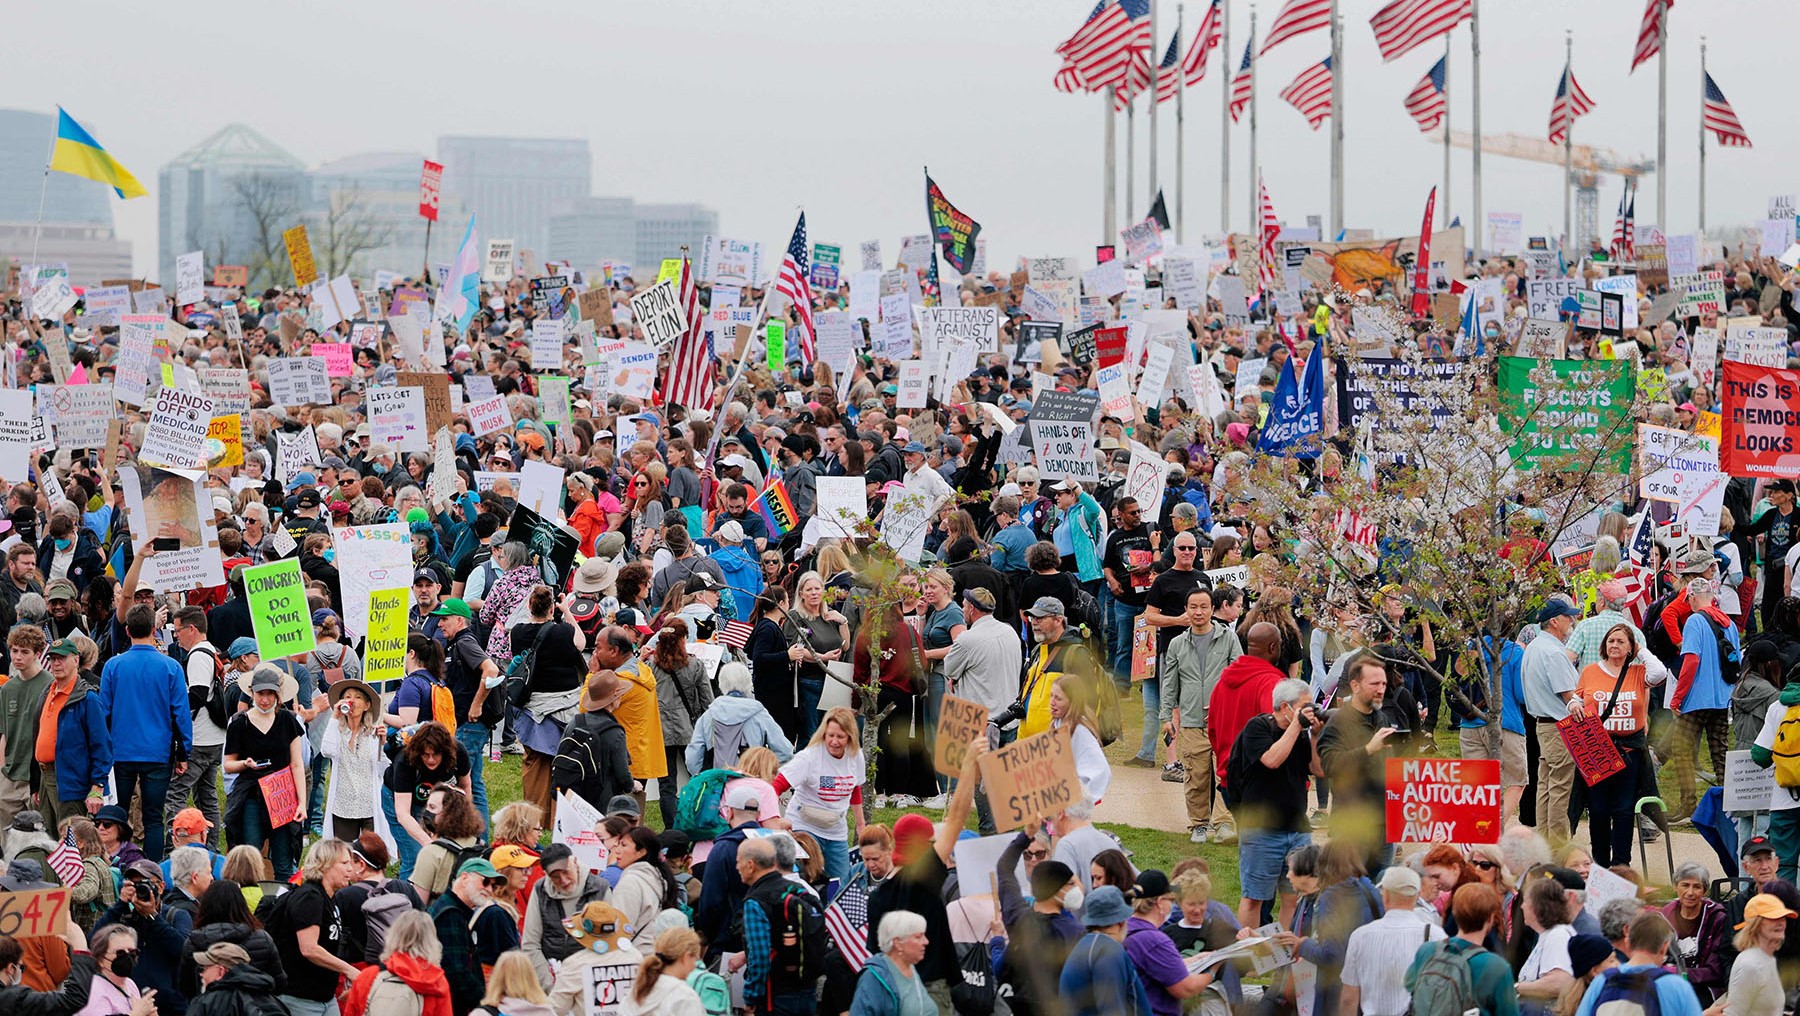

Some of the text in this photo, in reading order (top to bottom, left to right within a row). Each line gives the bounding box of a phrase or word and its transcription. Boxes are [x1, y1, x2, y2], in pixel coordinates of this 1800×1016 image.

[1776, 195, 1790, 208] ALL
[490, 250, 510, 259] OFF
[1531, 282, 1576, 297] FREE
[634, 281, 675, 323] DEPORT
[1697, 302, 1718, 314] YOU
[713, 310, 751, 321] RED BLUE
[932, 309, 994, 324] VETERANS
[646, 308, 682, 347] ELON
[935, 324, 992, 336] AGAINST
[1070, 331, 1094, 346] DIVERS
[1098, 332, 1118, 341] SAVE
[598, 342, 625, 354] ETURN
[621, 353, 655, 364] SENDER
[1390, 364, 1410, 375] NO
[1381, 380, 1410, 392] THE
[1727, 381, 1792, 400] THIS IS
[160, 388, 213, 412] HANDS
[394, 390, 410, 399] GET
[1042, 391, 1052, 399] This
[157, 400, 186, 416] OFF
[384, 403, 405, 412] GOOD
[471, 398, 502, 418] DEPORT
[1353, 397, 1371, 410] OF
[480, 414, 504, 431] MUSK
[1049, 411, 1076, 419] RIGHT
[153, 414, 206, 435] MEDICAID
[150, 424, 203, 444] $880 BILLION
[156, 434, 184, 445] MEDICAID
[1038, 425, 1086, 440] HANDS OFF
[153, 441, 168, 449] FUND
[179, 448, 198, 457] BREAKS
[1056, 442, 1074, 455] OUR
[1673, 436, 1689, 447] THE
[1736, 434, 1793, 452] LOOKS
[166, 453, 196, 467] RICH!
[1045, 459, 1094, 476] DEMOCRACY
[1649, 483, 1678, 496] OF OUR
[765, 489, 790, 527] RESIST
[904, 518, 917, 528] YOU
[341, 527, 410, 544] 20 LESSON
[160, 566, 190, 575] EXECUTED
[155, 575, 186, 584] attempting
[248, 570, 301, 595] CONGRESS
[269, 597, 290, 611] DO
[371, 597, 399, 610] Hands
[266, 611, 301, 629] YOUR
[370, 610, 387, 623] Off
[275, 628, 303, 645] DUTY
[368, 638, 405, 652] VOTING
[368, 656, 404, 672] RIGHTS!
[944, 699, 984, 724] MUSK
[940, 721, 979, 743] MUST
[997, 729, 1062, 772] TRUMP'S
[1563, 726, 1597, 773] LOOKS LIKE
[1013, 758, 1057, 793] MUSK
[1403, 761, 1462, 783] MAKE
[1386, 783, 1501, 806] The AUTOCRAT
[1403, 802, 1432, 822] GO
[1401, 820, 1456, 843] AWAY
[592, 964, 640, 982] HAND
